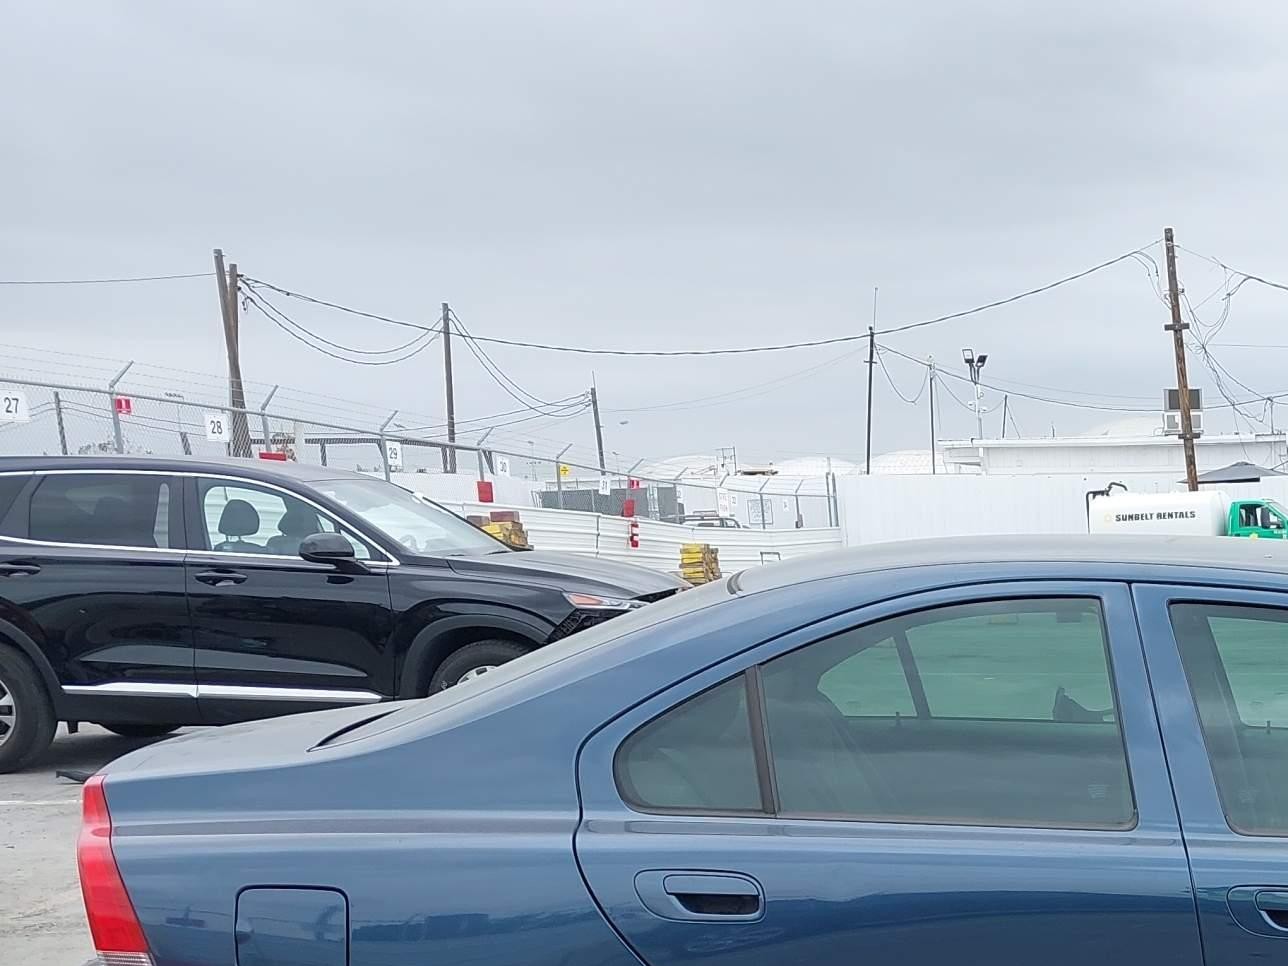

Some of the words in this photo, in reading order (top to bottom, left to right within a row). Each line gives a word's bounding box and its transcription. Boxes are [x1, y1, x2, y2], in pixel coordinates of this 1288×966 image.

[4, 396, 20, 414] 27
[209, 420, 223, 434] 28
[388, 446, 398, 460] 29
[1115, 513, 1154, 522] SUNBELT
[1156, 511, 1196, 520] RENTALS
